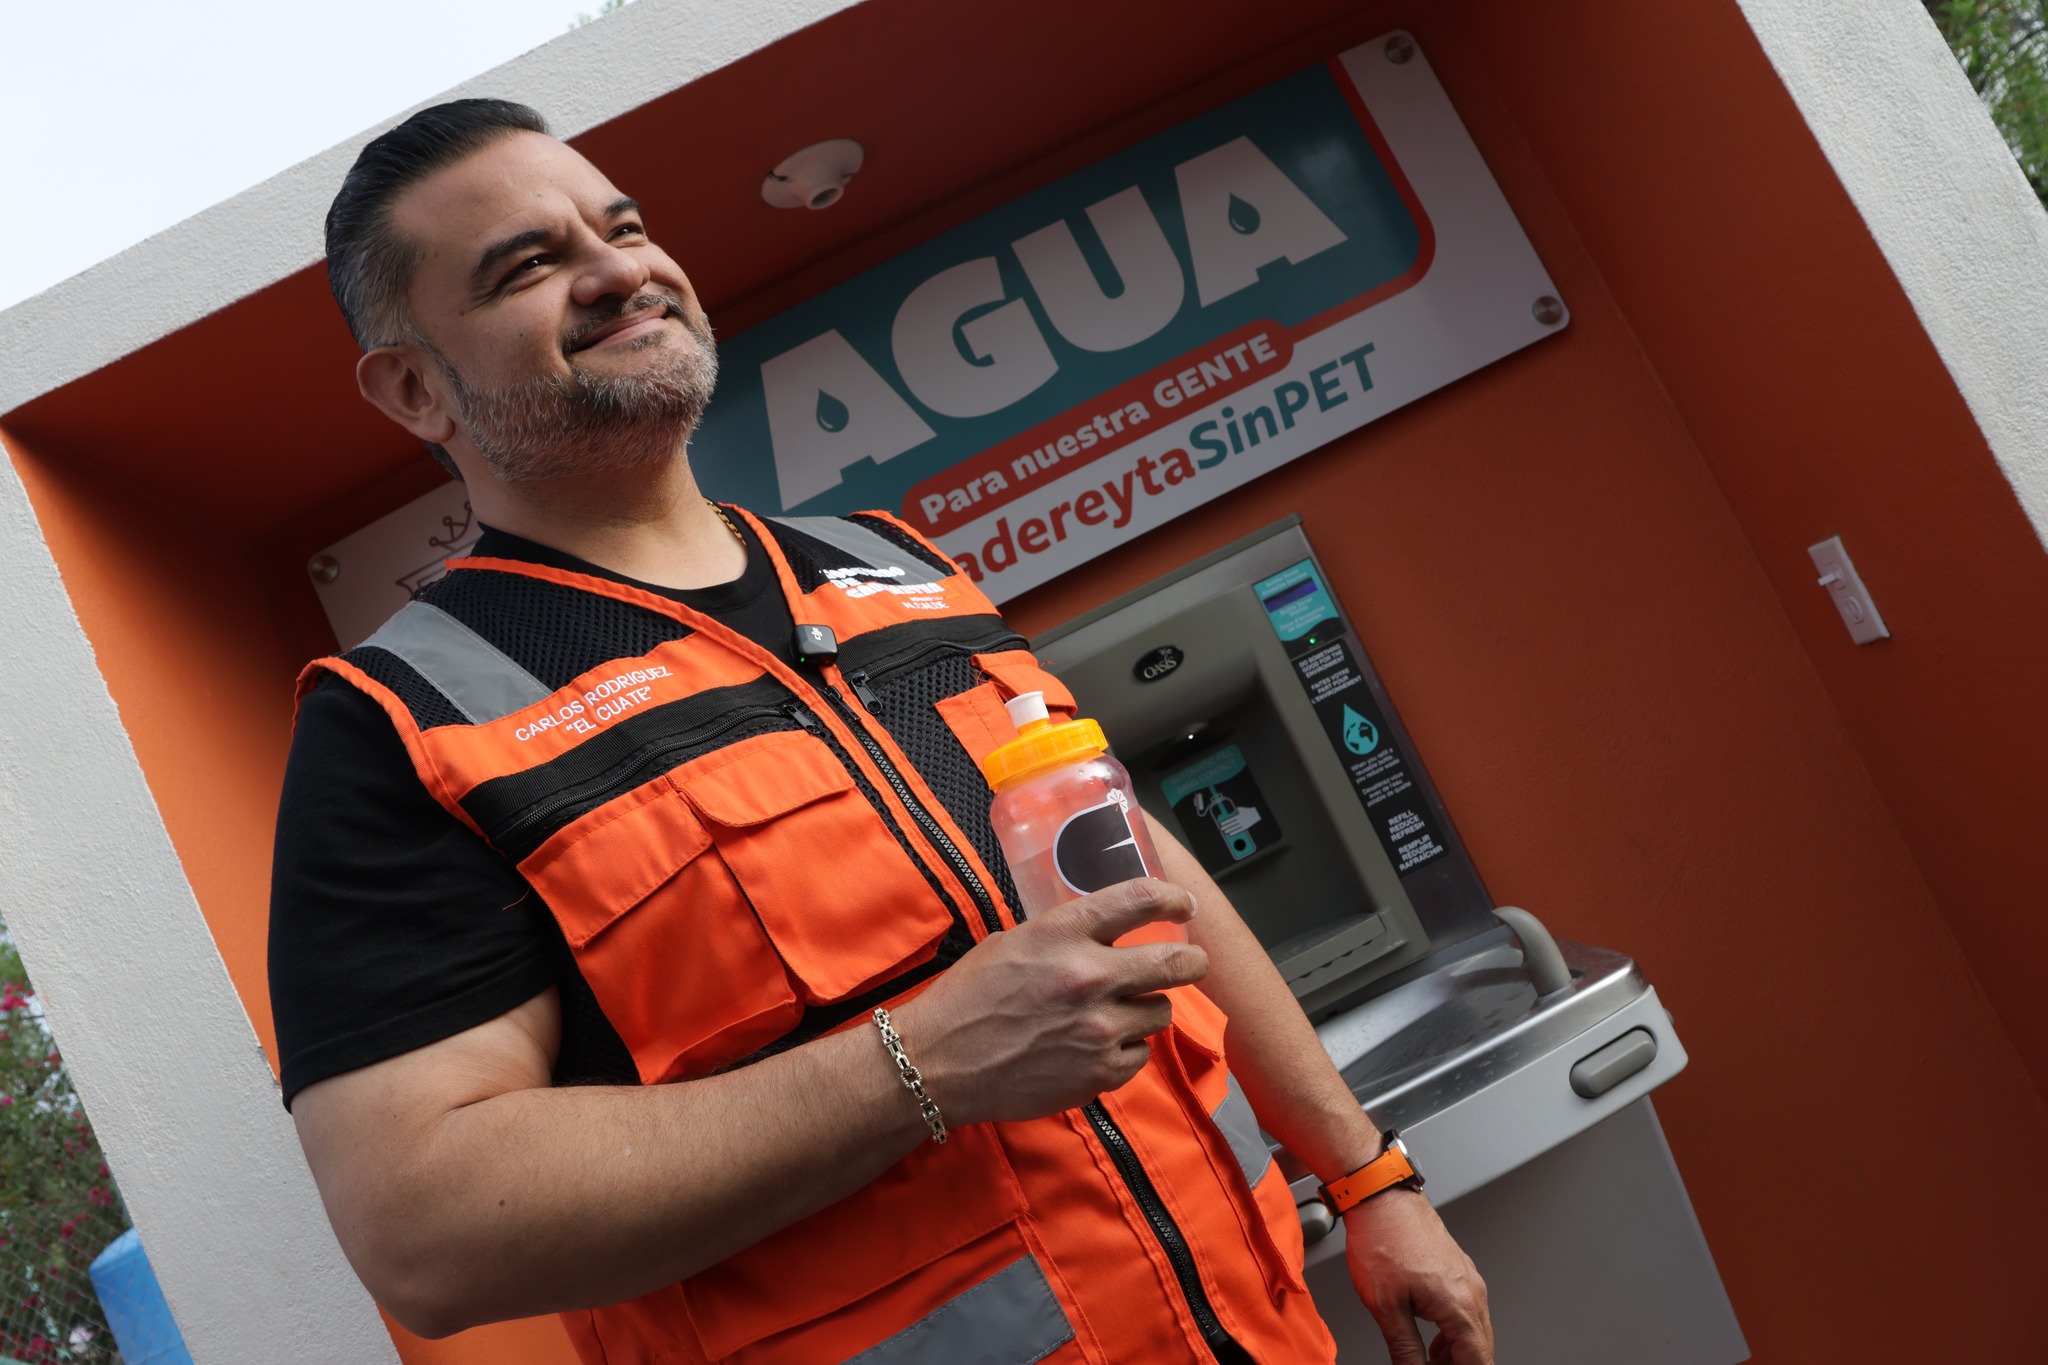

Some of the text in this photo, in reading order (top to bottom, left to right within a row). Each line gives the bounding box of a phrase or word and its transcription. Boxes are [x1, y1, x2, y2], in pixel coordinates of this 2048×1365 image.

[760, 135, 1349, 512] AGUA
[919, 332, 1277, 524] Para nuestra GENTE
[1143, 655, 1177, 679] OASIS
[1299, 643, 1341, 668] DO SOMETHING
[1302, 648, 1343, 674] GOOD FOR THE
[1305, 655, 1345, 679] ENVIRONMENT
[1311, 667, 1350, 691] FAITES VOTRE
[1317, 674, 1350, 694] PART POUR
[515, 665, 674, 741] CARLOS RODRIGUEZ
[1388, 809, 1415, 826] REFILL
[1389, 814, 1420, 834] REDUCE
[1390, 820, 1425, 842] REFRESH
[1398, 834, 1431, 855] REMPLIR
